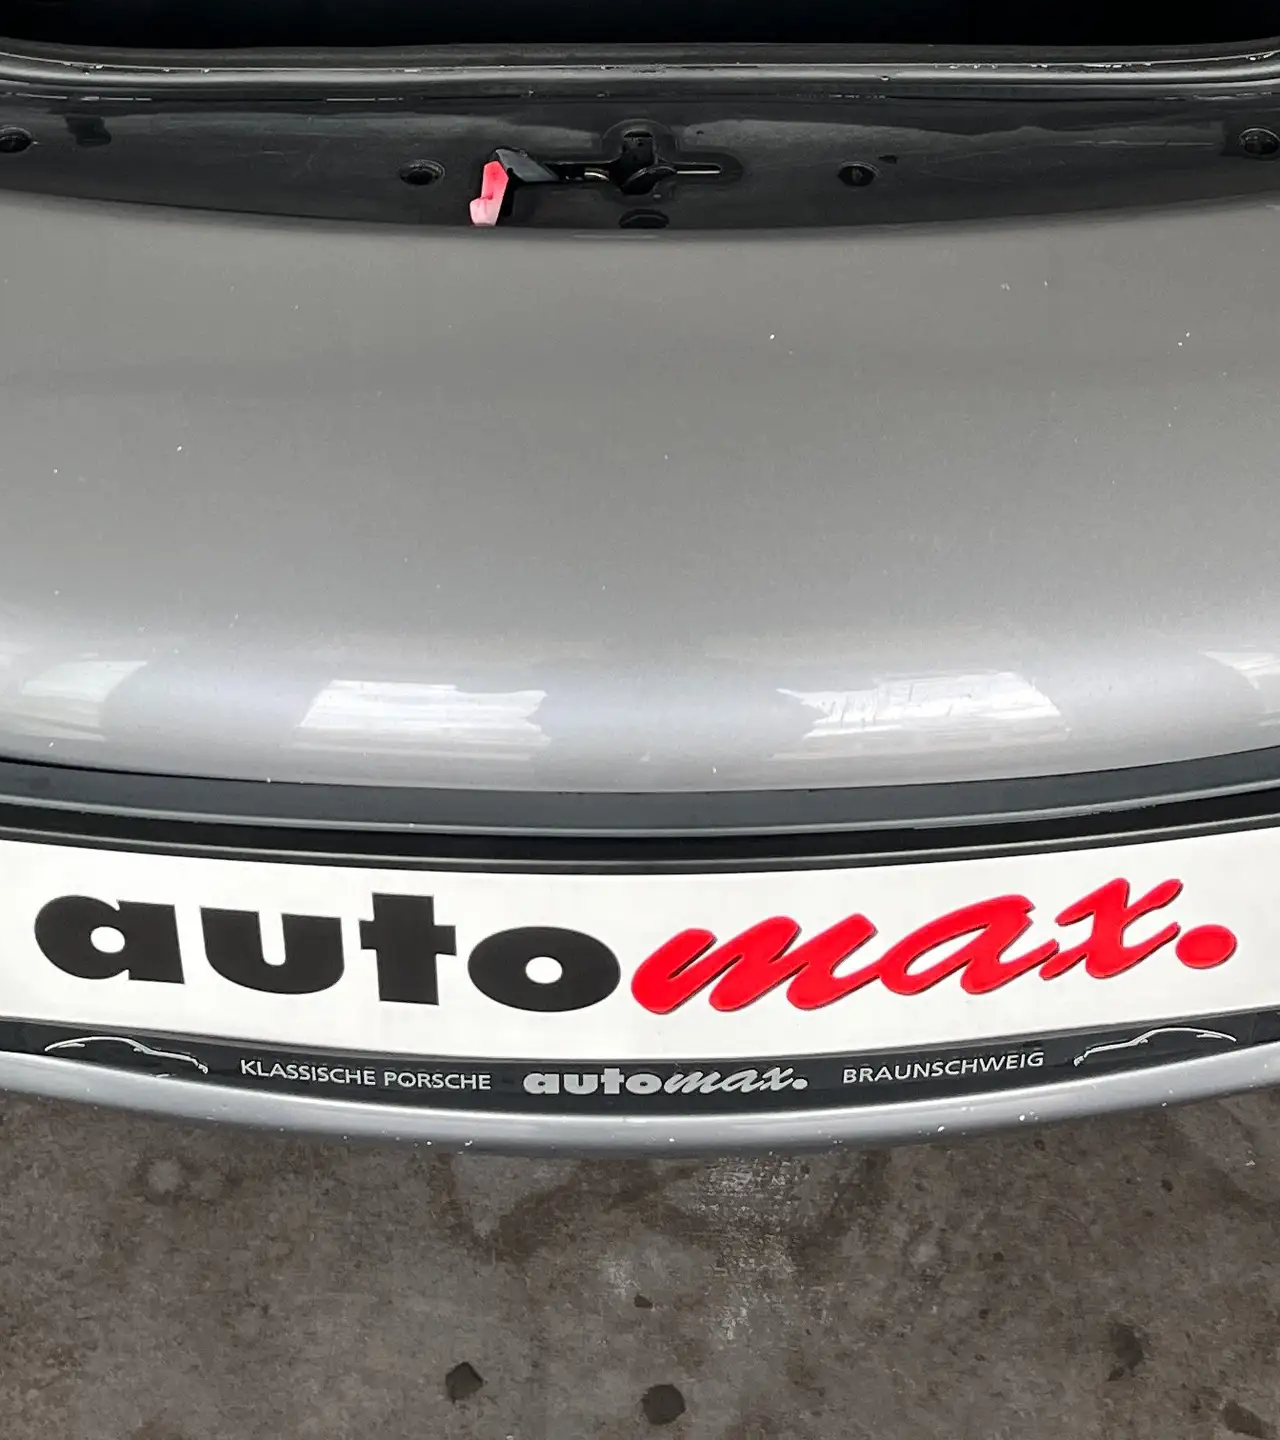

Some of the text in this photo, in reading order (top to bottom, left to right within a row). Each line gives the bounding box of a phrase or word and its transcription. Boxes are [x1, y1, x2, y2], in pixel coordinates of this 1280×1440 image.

[240, 1059, 376, 1086] KLASSISCHE
[384, 1071, 492, 1090] PORSCHE
[843, 1051, 1045, 1084] BRAUNSCHWEIG
